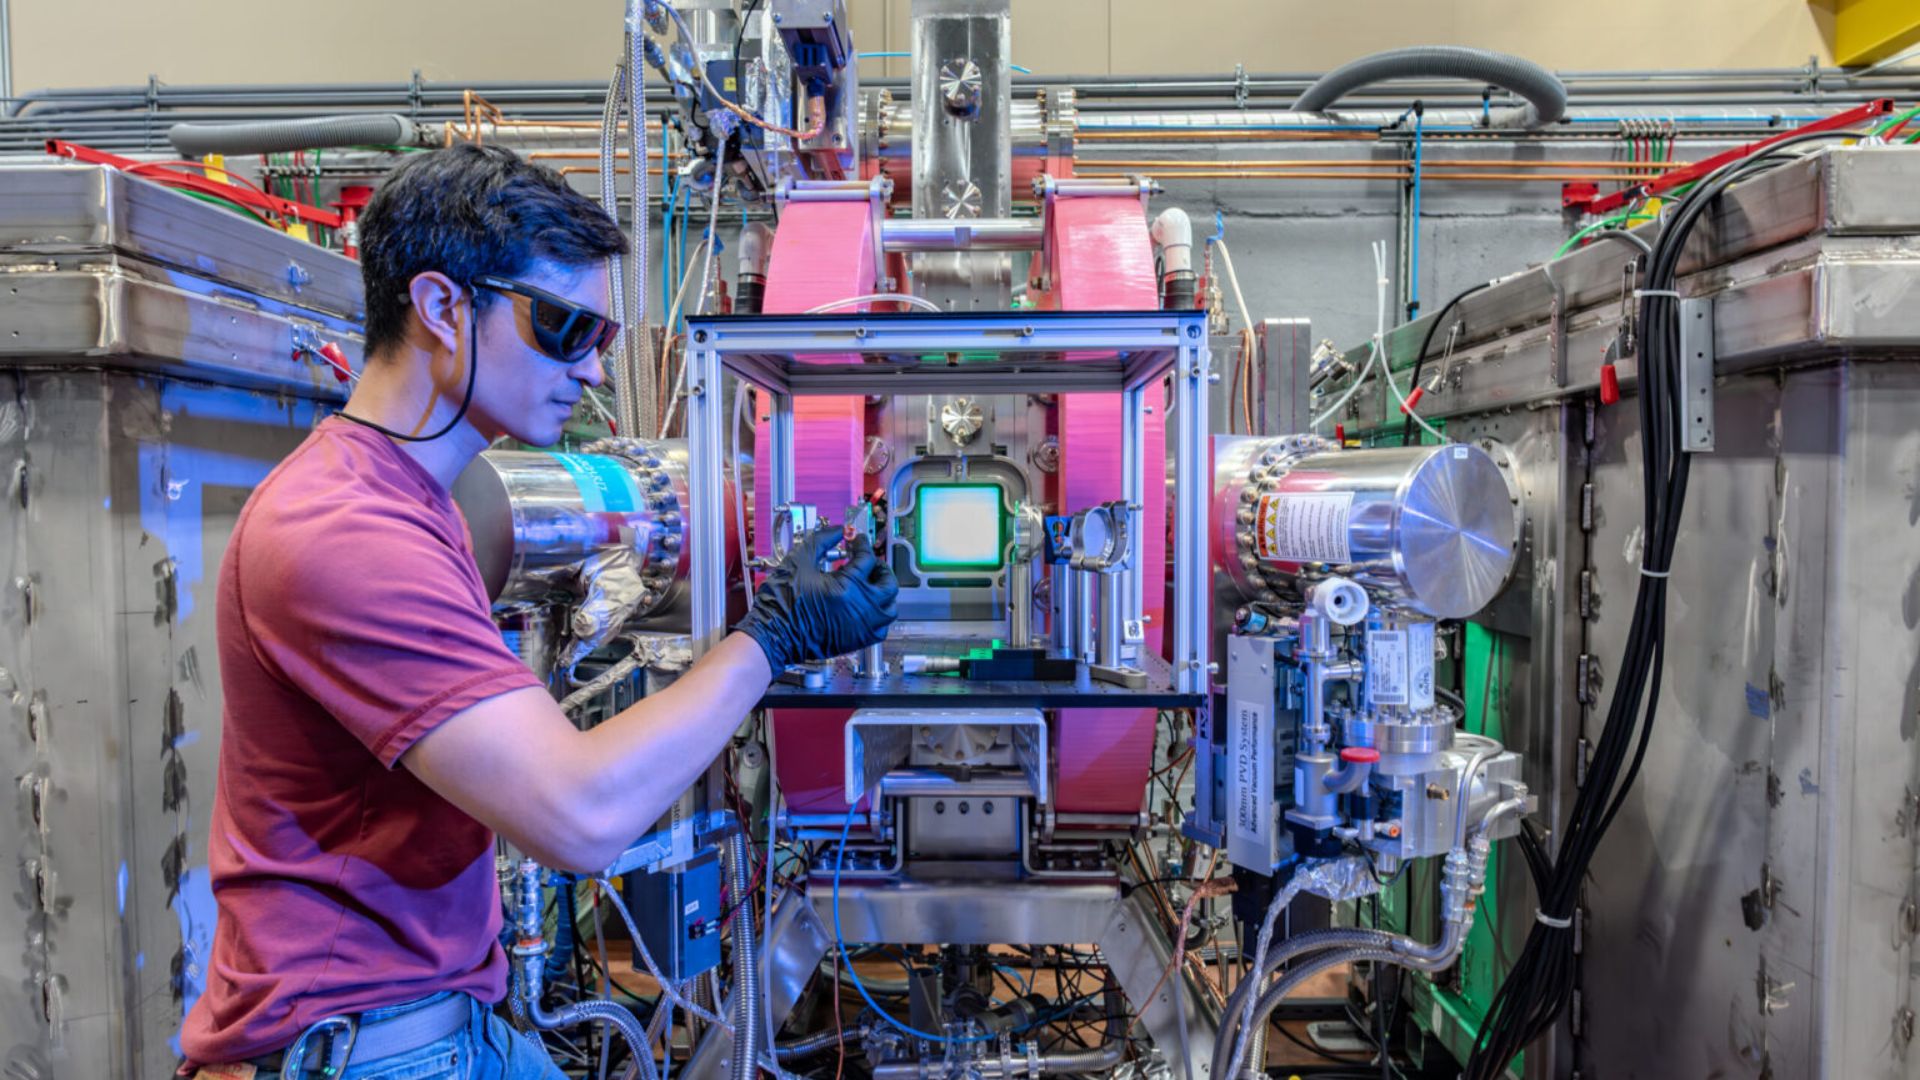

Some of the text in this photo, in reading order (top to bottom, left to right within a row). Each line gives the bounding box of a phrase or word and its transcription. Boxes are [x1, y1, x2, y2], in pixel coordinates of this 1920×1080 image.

[1239, 710, 1250, 752] System
[1250, 712, 1258, 761] Performance
[1239, 754, 1248, 784] PVD
